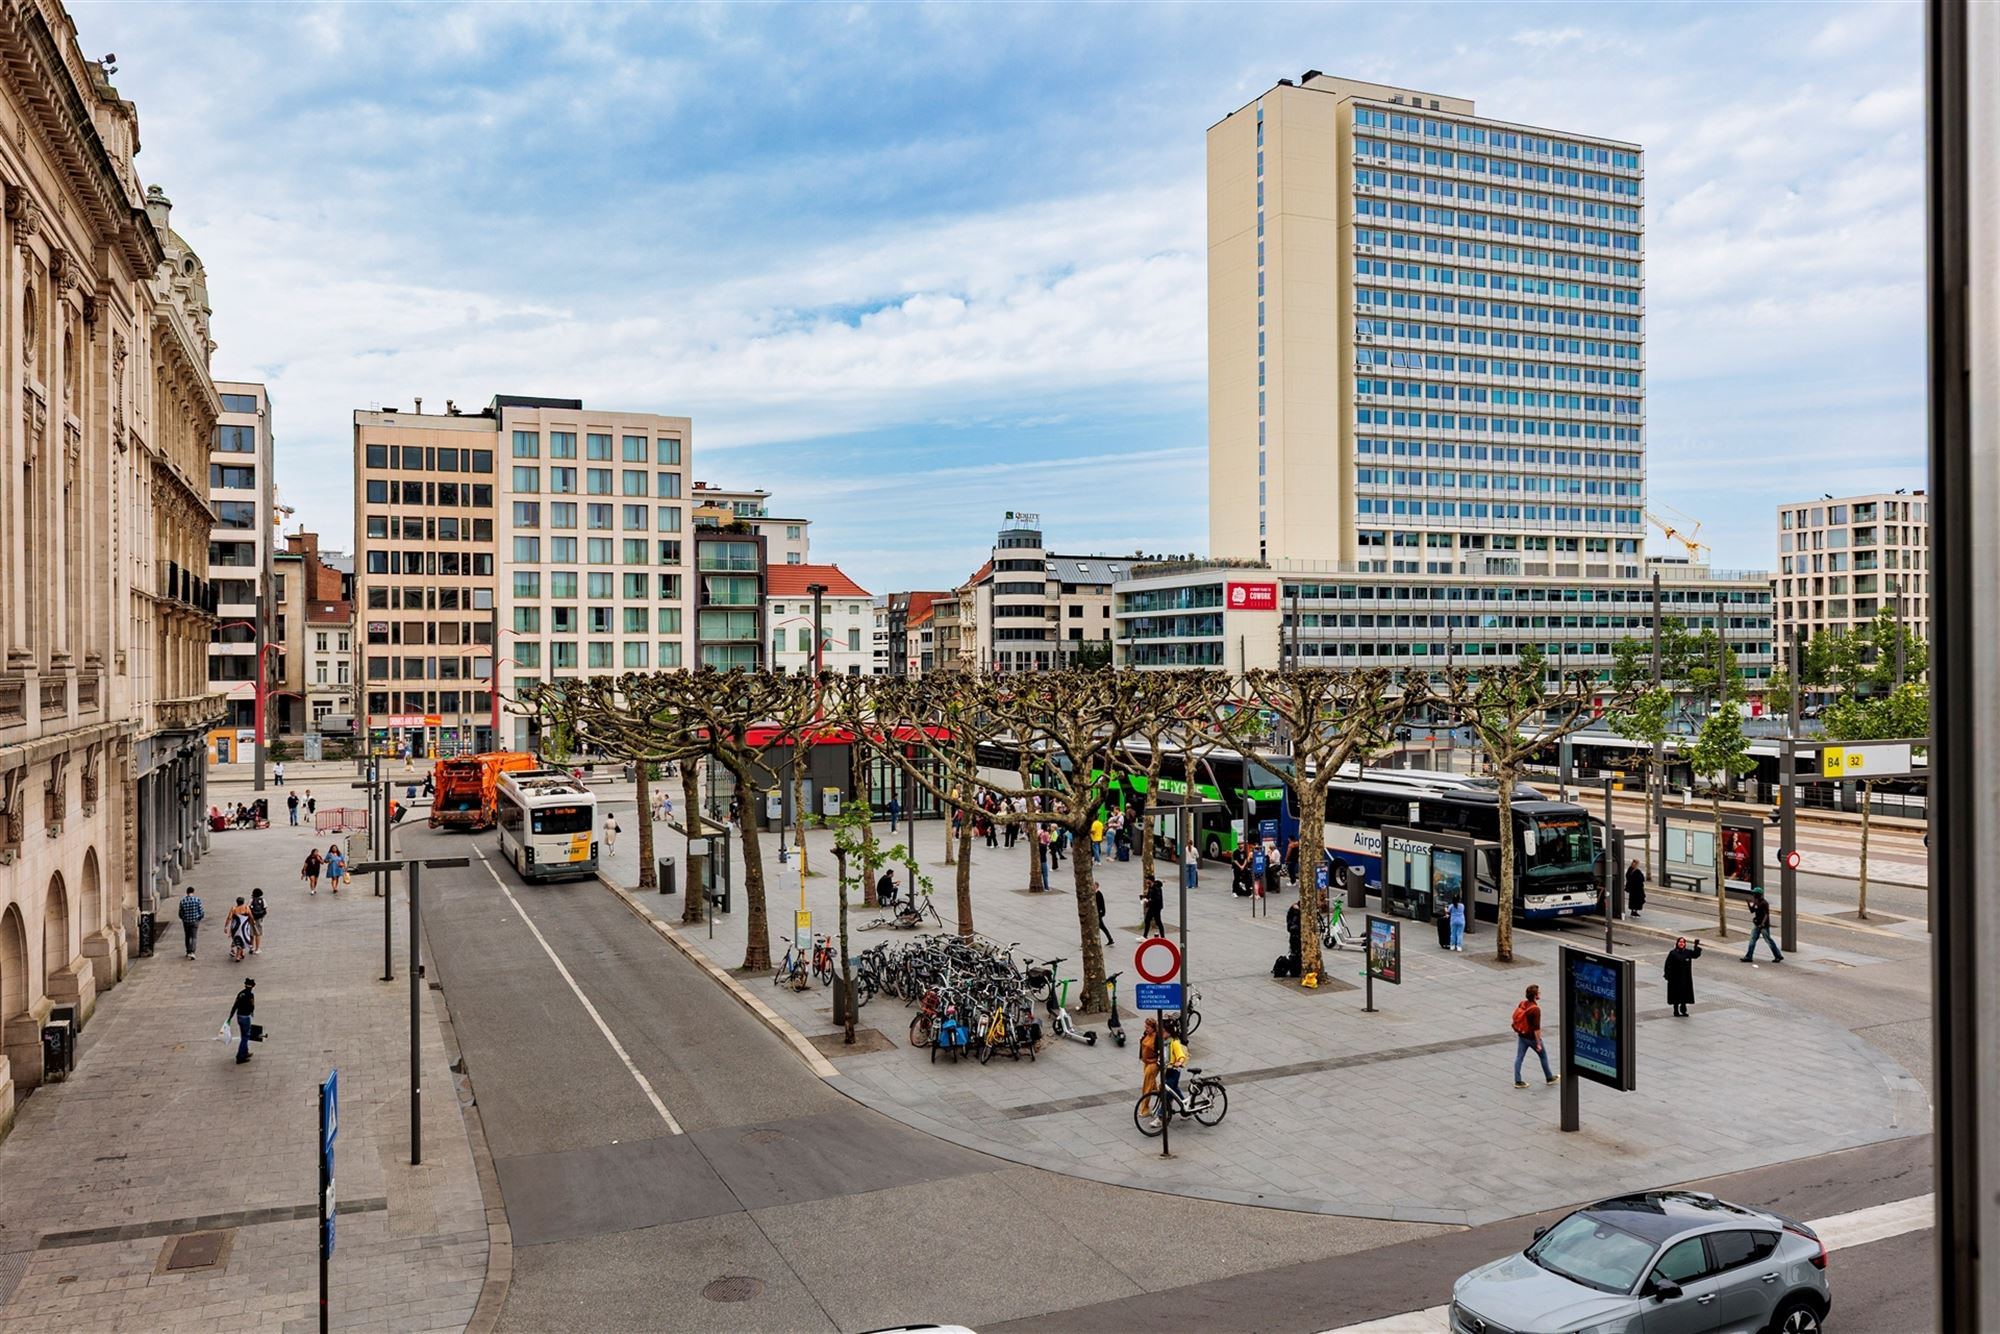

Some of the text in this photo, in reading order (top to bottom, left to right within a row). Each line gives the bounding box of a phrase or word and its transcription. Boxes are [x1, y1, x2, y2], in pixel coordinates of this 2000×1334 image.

[1015, 511, 1040, 519] QUALITY
[1827, 756, 1860, 767] B4 32
[1354, 832, 1382, 850] Airpo
[1575, 981, 1616, 998] CHALLENGE
